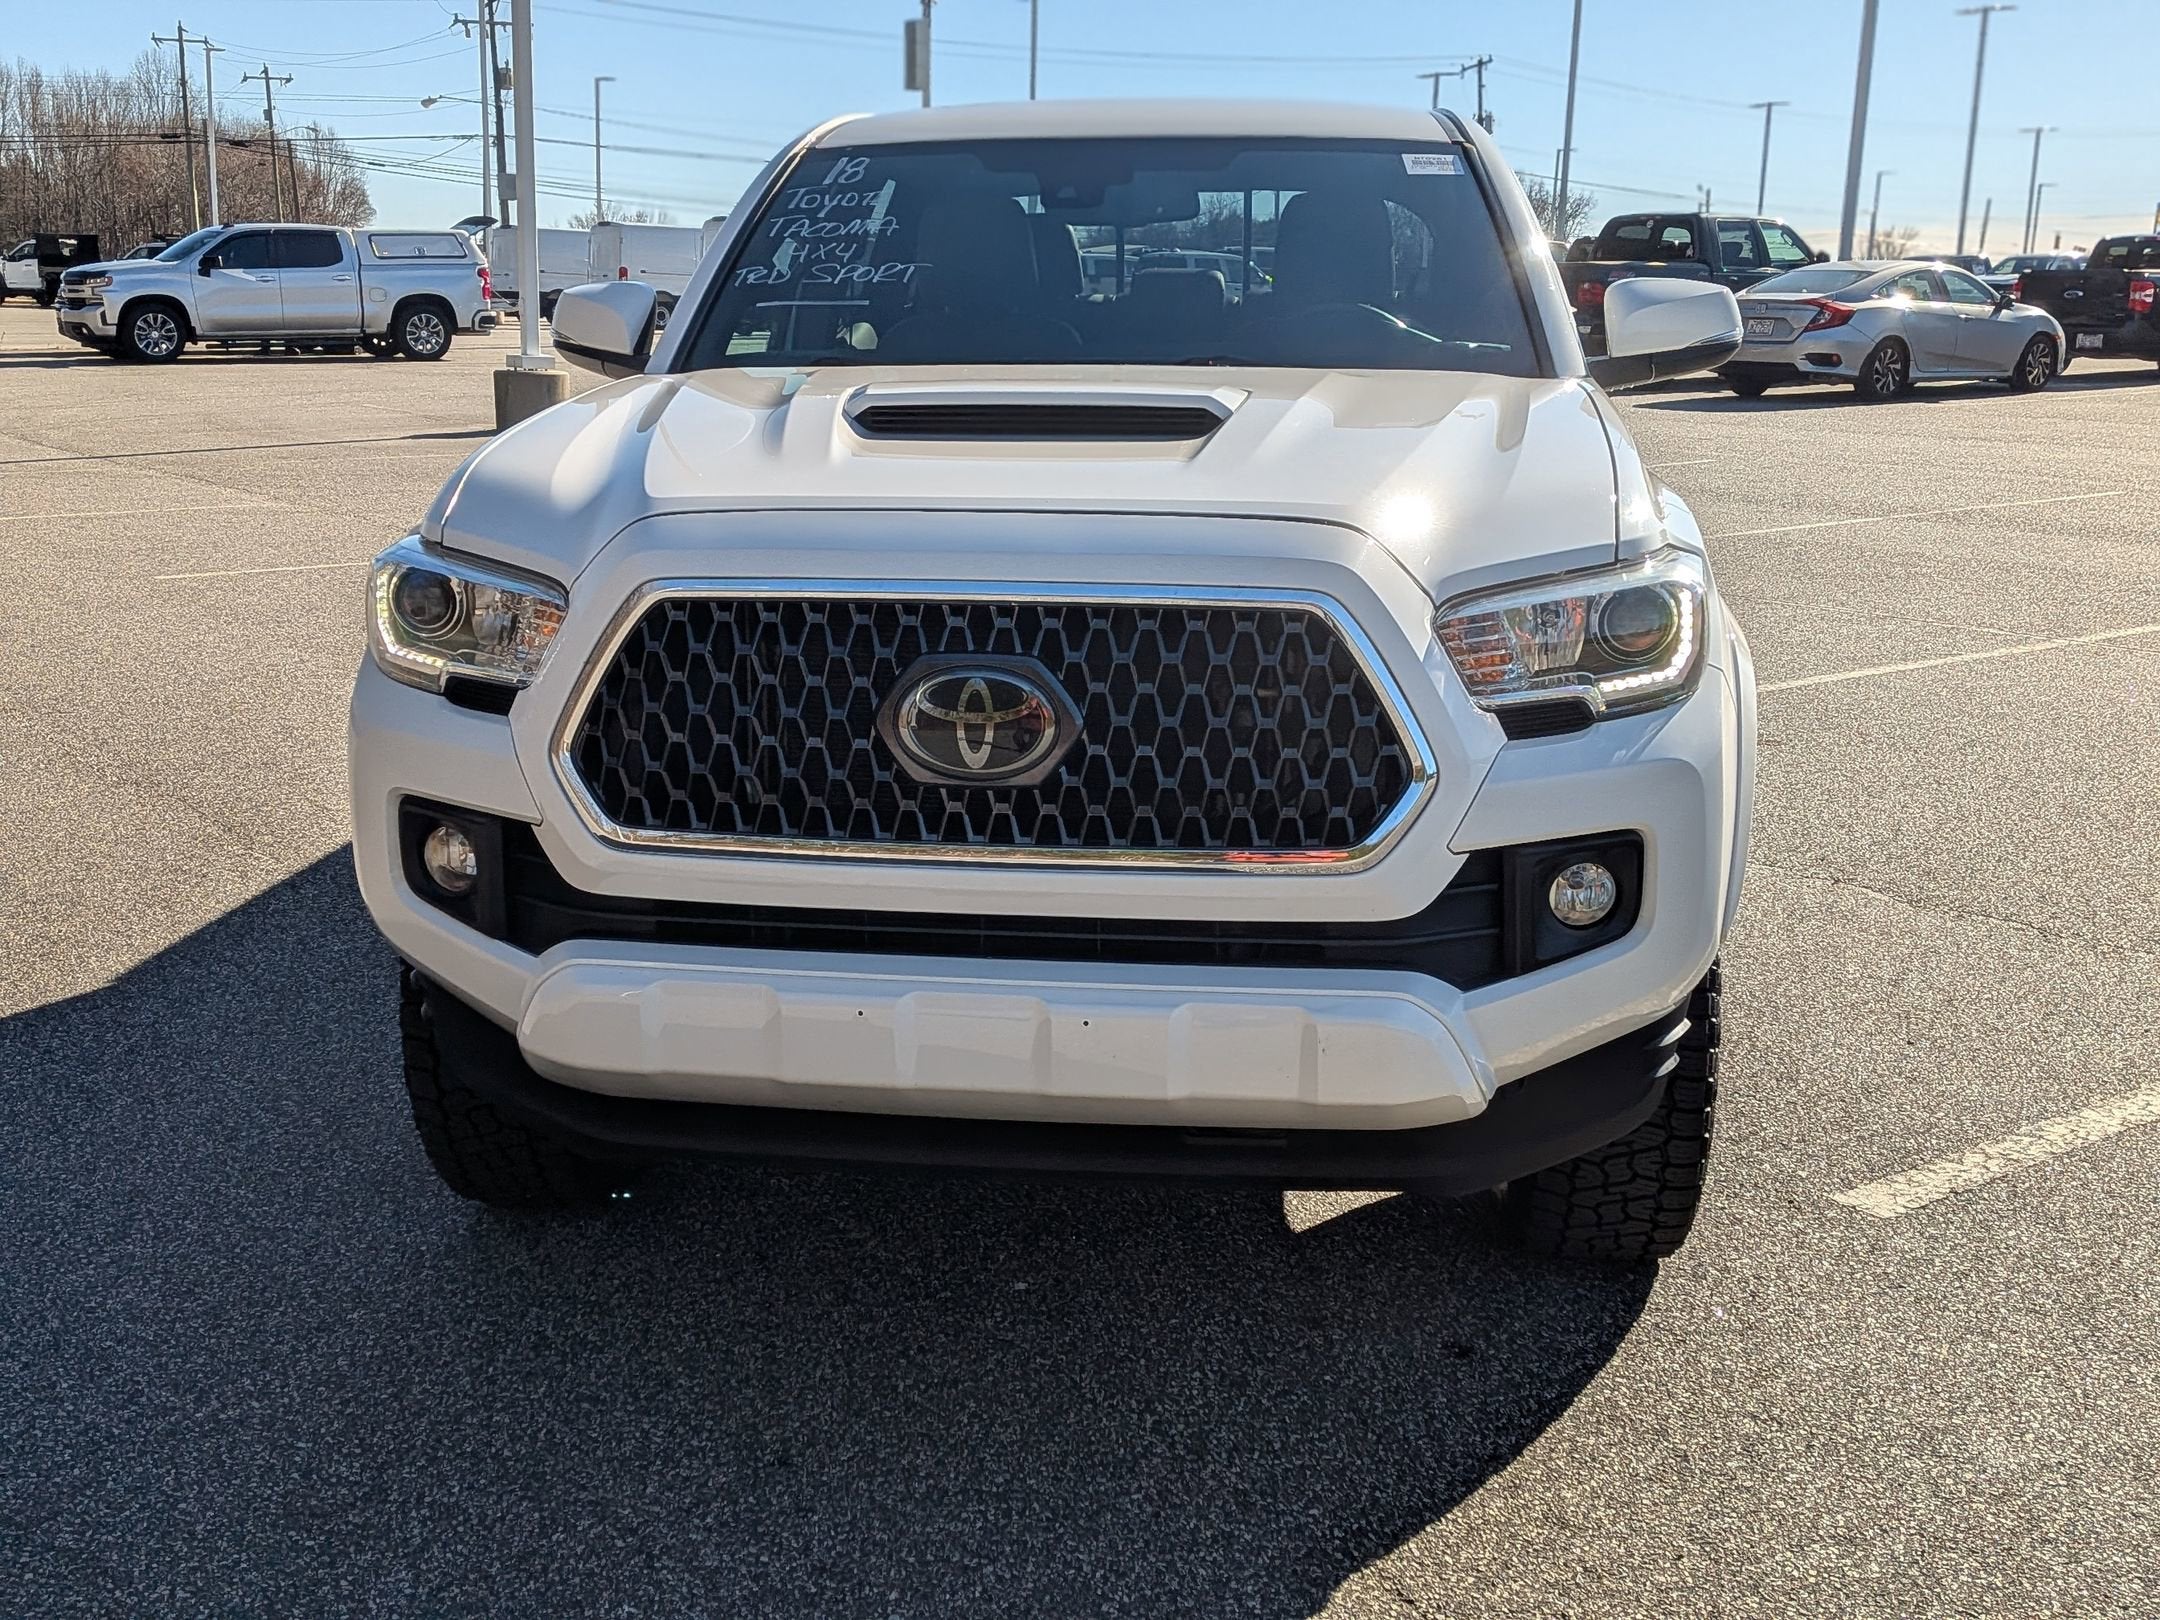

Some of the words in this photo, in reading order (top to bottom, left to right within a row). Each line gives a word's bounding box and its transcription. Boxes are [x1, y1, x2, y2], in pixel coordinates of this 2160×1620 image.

[822, 157, 870, 185] 18
[787, 185, 888, 217] TOYOT
[769, 215, 900, 237] TACOMA
[734, 266, 791, 287] TRD
[802, 263, 933, 284] SPORT
